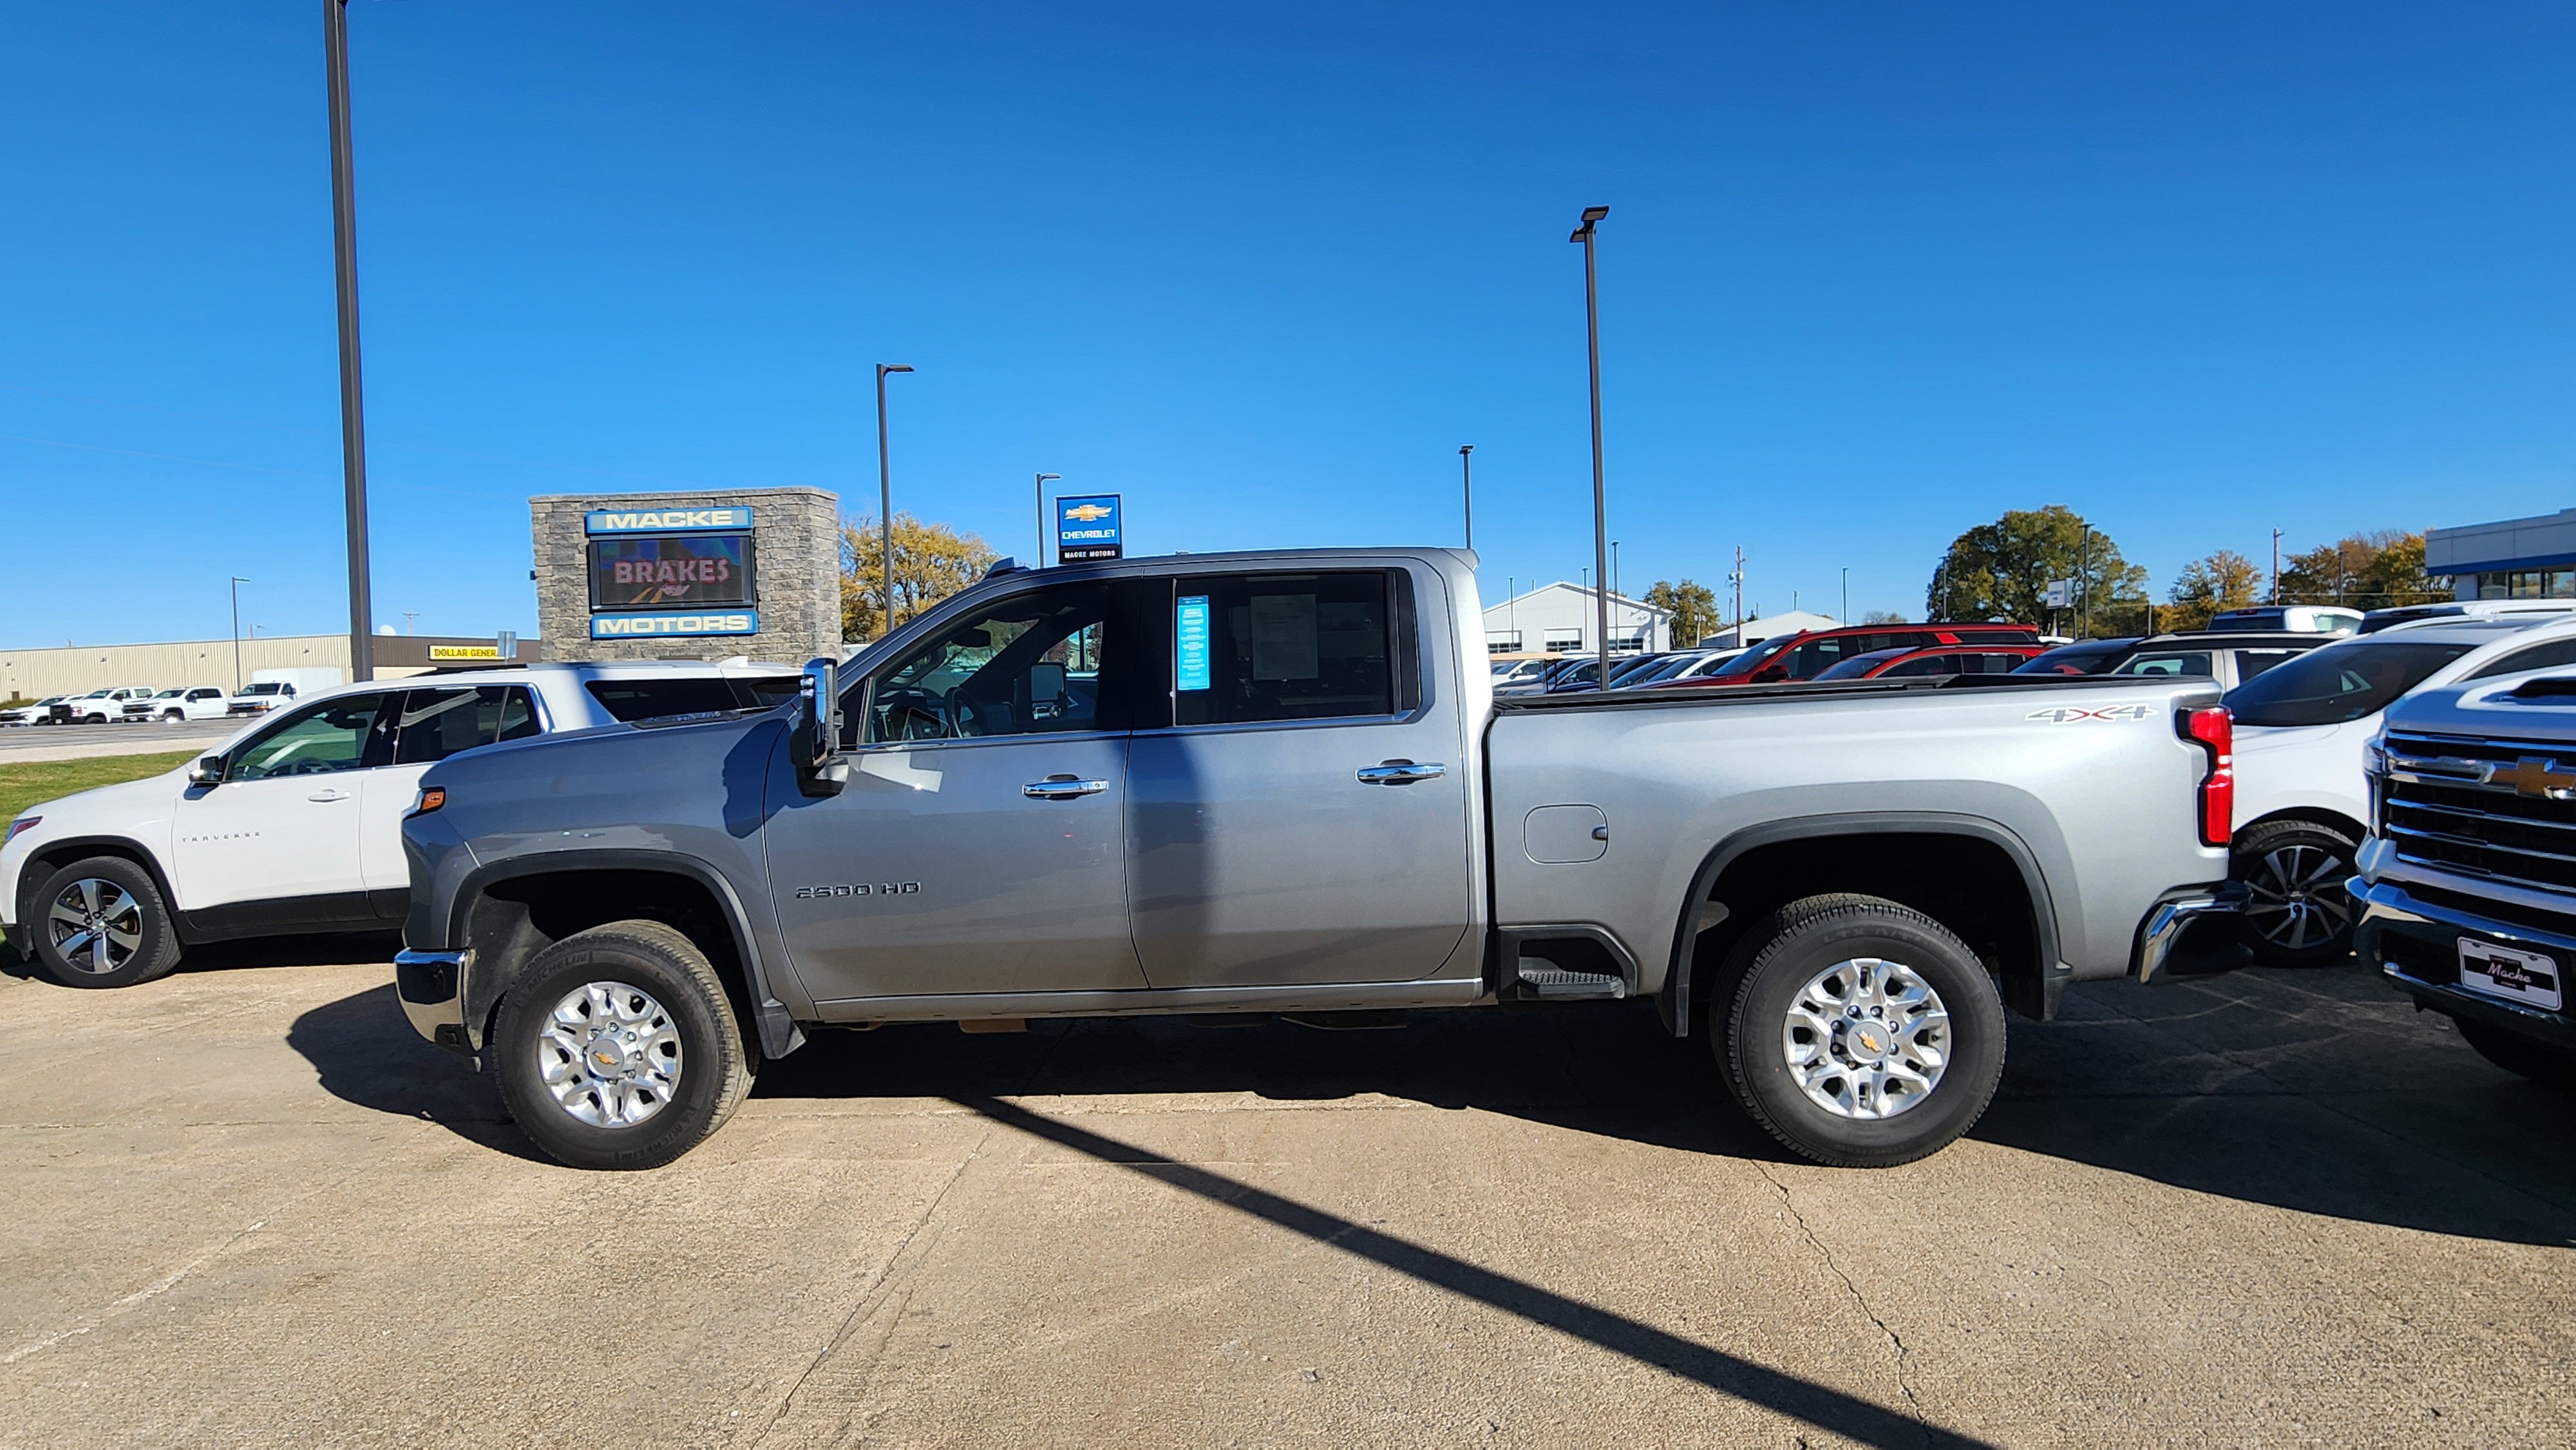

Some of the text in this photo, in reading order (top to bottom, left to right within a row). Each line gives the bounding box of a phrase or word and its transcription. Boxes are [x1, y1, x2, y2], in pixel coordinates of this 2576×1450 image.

[605, 511, 732, 529] MACKE
[1062, 529, 1115, 540] CHEVROLET
[614, 558, 730, 583] BRAKES
[600, 615, 748, 634] MOTORS
[434, 648, 497, 657] DOLLAR GENER
[182, 831, 260, 843] TRAVERSE
[796, 881, 921, 899] 2500 HD
[529, 953, 585, 990] MICHELIN
[2487, 962, 2531, 983] Macke
